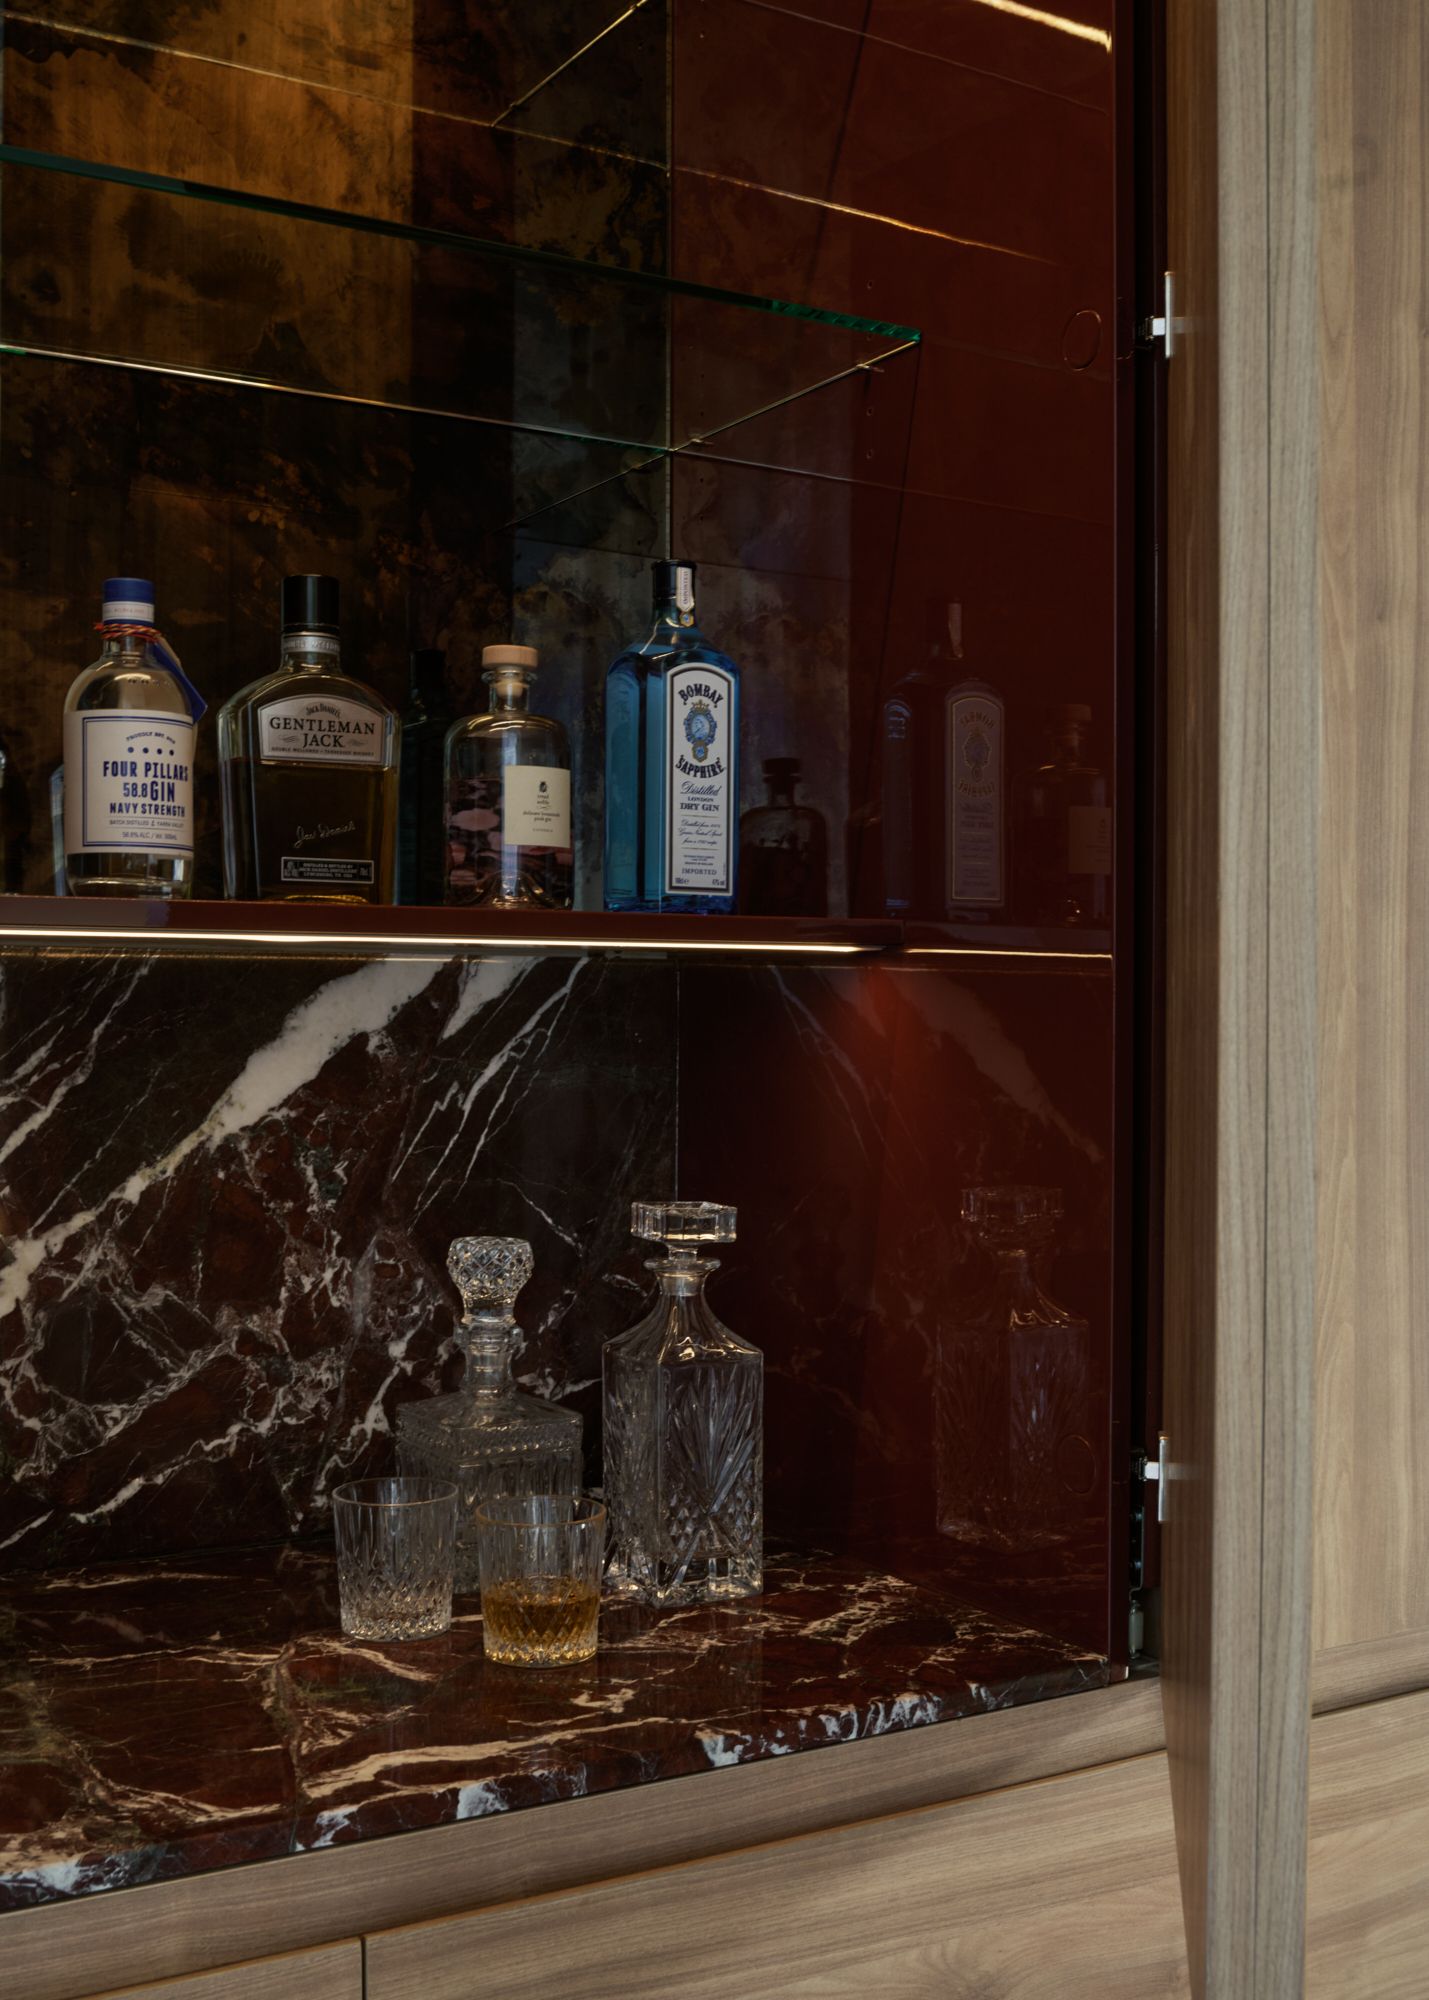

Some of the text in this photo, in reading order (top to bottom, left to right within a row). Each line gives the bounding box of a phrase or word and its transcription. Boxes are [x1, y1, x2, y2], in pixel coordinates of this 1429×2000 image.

[678, 684, 724, 709] BOMBAY
[270, 716, 375, 735] GENTLEMAN
[302, 733, 344, 748] JACK
[103, 761, 188, 781] FOUR PILLARS
[675, 755, 724, 779] SAPPHIRE
[123, 781, 175, 802] 58.8 GIN
[680, 781, 722, 797] Distilled
[110, 803, 185, 817] NAVY STRENGTH
[680, 803, 720, 812] DRY GIN
